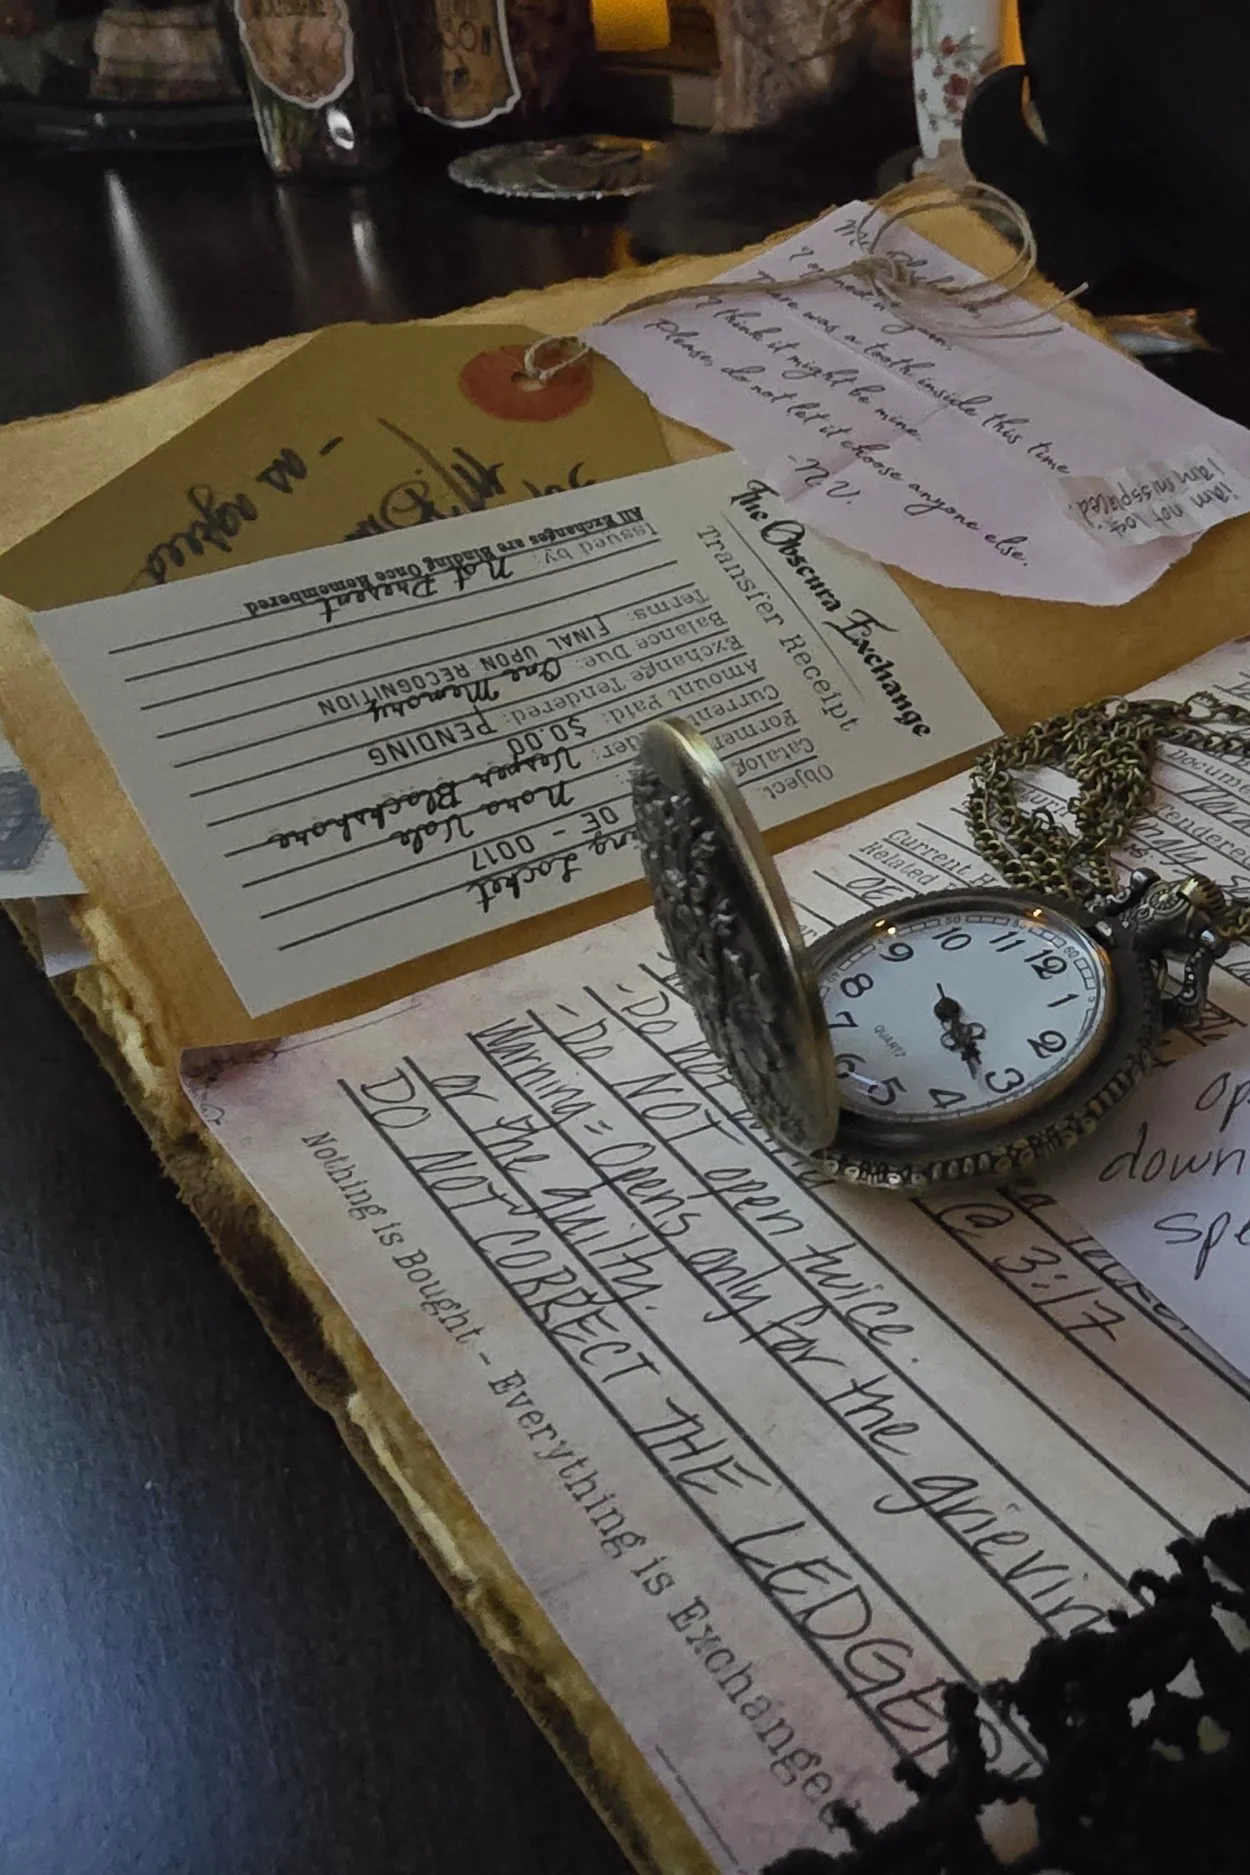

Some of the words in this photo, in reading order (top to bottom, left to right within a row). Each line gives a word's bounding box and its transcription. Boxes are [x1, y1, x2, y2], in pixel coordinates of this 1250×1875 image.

[713, 308, 783, 341] think
[767, 340, 801, 354] it
[781, 355, 860, 388] might
[849, 385, 886, 404] be
[864, 342, 935, 375] tooth
[918, 378, 992, 417] inside
[982, 413, 1029, 444] this
[1027, 441, 1070, 474] time
[751, 385, 799, 403] not
[786, 402, 831, 424] let
[819, 424, 852, 438] it
[841, 440, 904, 481] choose
[903, 481, 980, 530] anyone
[984, 535, 1028, 567] else.
[530, 513, 617, 544] Exchanges
[616, 505, 645, 524] All
[421, 545, 495, 567] Binding
[496, 537, 525, 553] are
[579, 521, 660, 552] Issued
[374, 562, 422, 583] Once
[243, 574, 370, 618] Remembered
[731, 479, 780, 522] The
[761, 519, 842, 613] Obscura
[819, 607, 931, 737] Exchange
[546, 613, 611, 652] FINAL
[638, 609, 729, 644] Balance
[696, 524, 785, 627] Transfer
[779, 633, 860, 733] Receipt
[480, 644, 540, 673] UPON
[632, 634, 745, 683] Exchange
[668, 658, 759, 700] Amount
[316, 662, 471, 718] RECOGNITION
[503, 676, 628, 727] Tendered:
[600, 696, 663, 725] Paid:
[368, 704, 498, 768] PENDING
[266, 780, 464, 849] Blackshore
[479, 778, 576, 816] Nora
[470, 835, 535, 873] 0017
[859, 839, 941, 887] Related
[887, 828, 969, 878] Current
[466, 851, 583, 914] Locket
[840, 972, 874, 999] 8
[1023, 949, 1068, 980] 12
[620, 991, 679, 1036] Do
[1026, 1030, 1068, 1059] 2
[928, 1088, 968, 1110] 4
[984, 1067, 1025, 1095] 3
[472, 1112, 552, 1174] the
[556, 1016, 614, 1063] Do
[609, 1072, 746, 1146] NOT
[685, 1167, 806, 1238] open
[1098, 1121, 1247, 1184] down
[360, 1065, 432, 1130] DO
[406, 1149, 507, 1212] NOT
[473, 1228, 662, 1385] CORRECT
[632, 1394, 774, 1497] THE
[991, 1245, 1126, 1342] 3:17
[300, 1130, 390, 1223] Nothing
[372, 1221, 405, 1248] is
[392, 1247, 486, 1346] Bought
[487, 1367, 648, 1561] Everything
[630, 1554, 675, 1599] is
[684, 1246, 785, 1323] only
[739, 1301, 847, 1367] for
[824, 1373, 922, 1457] the
